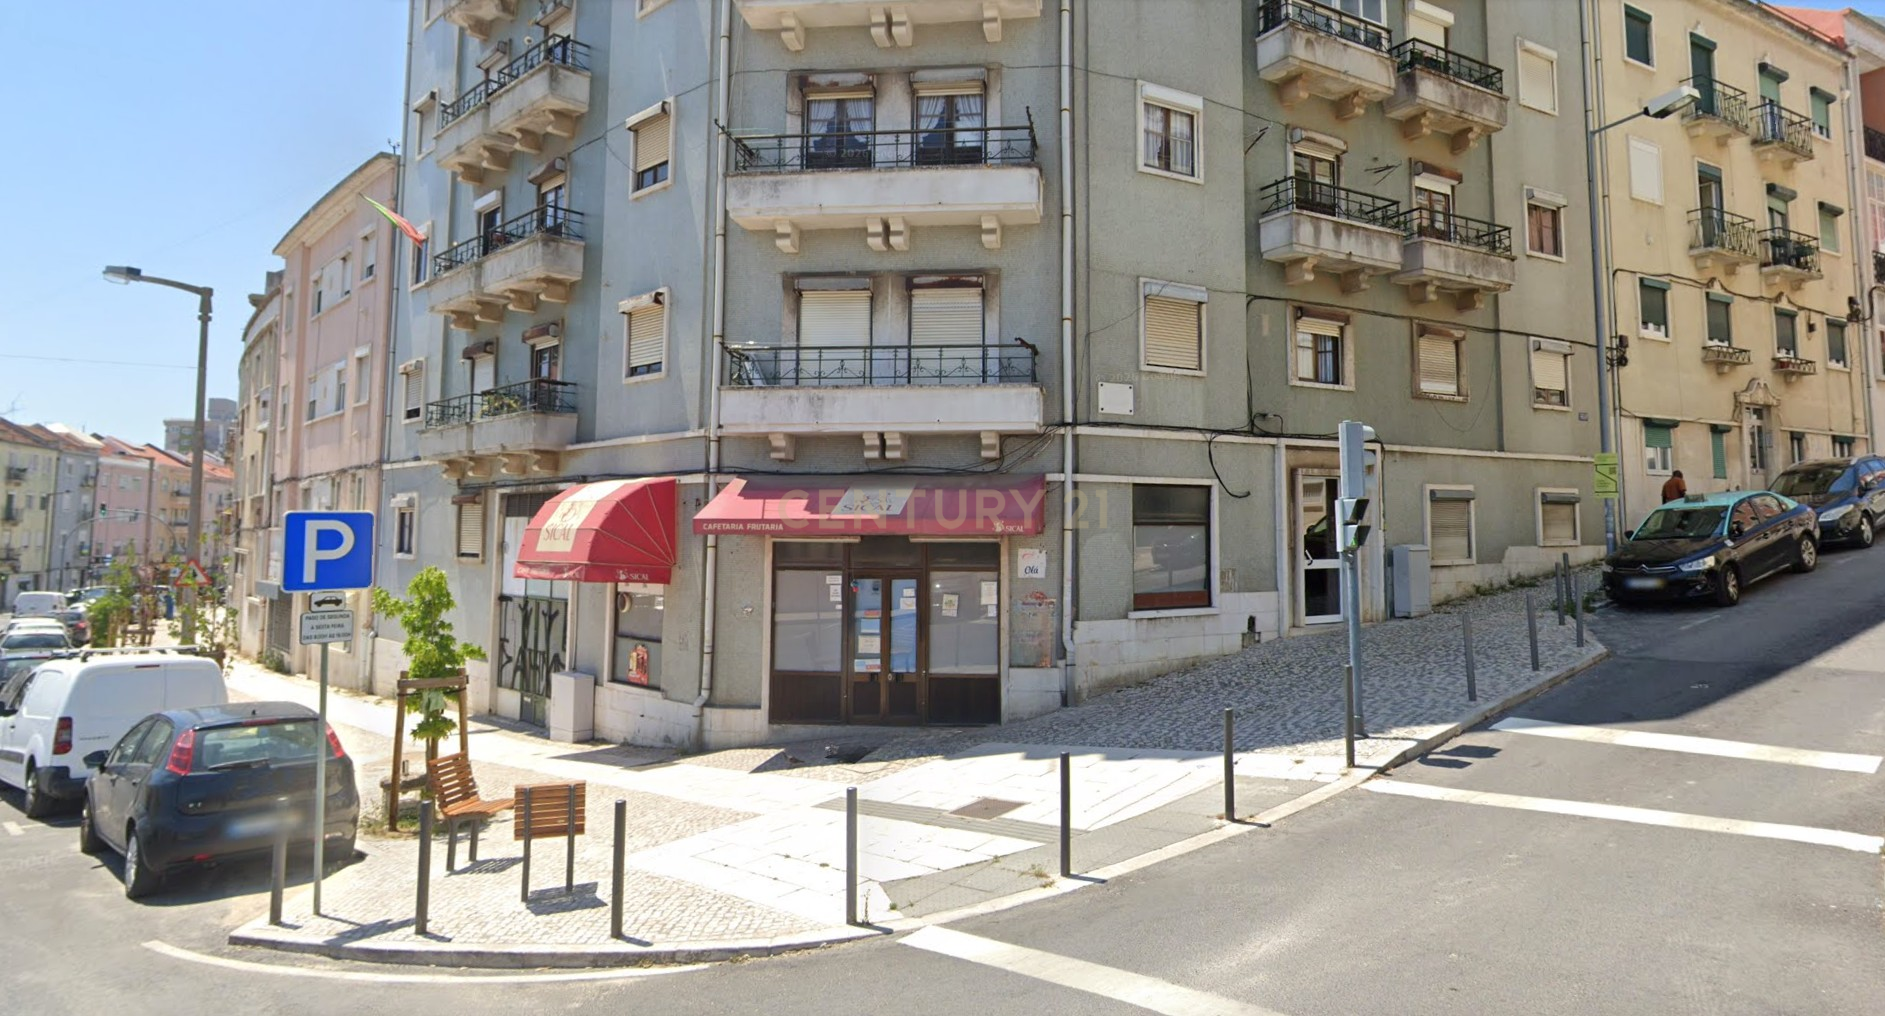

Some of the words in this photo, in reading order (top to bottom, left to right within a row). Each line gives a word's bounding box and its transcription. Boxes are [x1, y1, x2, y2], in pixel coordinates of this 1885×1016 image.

[543, 523, 574, 541] SICAL
[1005, 524, 1024, 532] SICAL
[303, 520, 355, 583] P
[1024, 565, 1039, 575] Olá
[629, 573, 648, 581] SICAL
